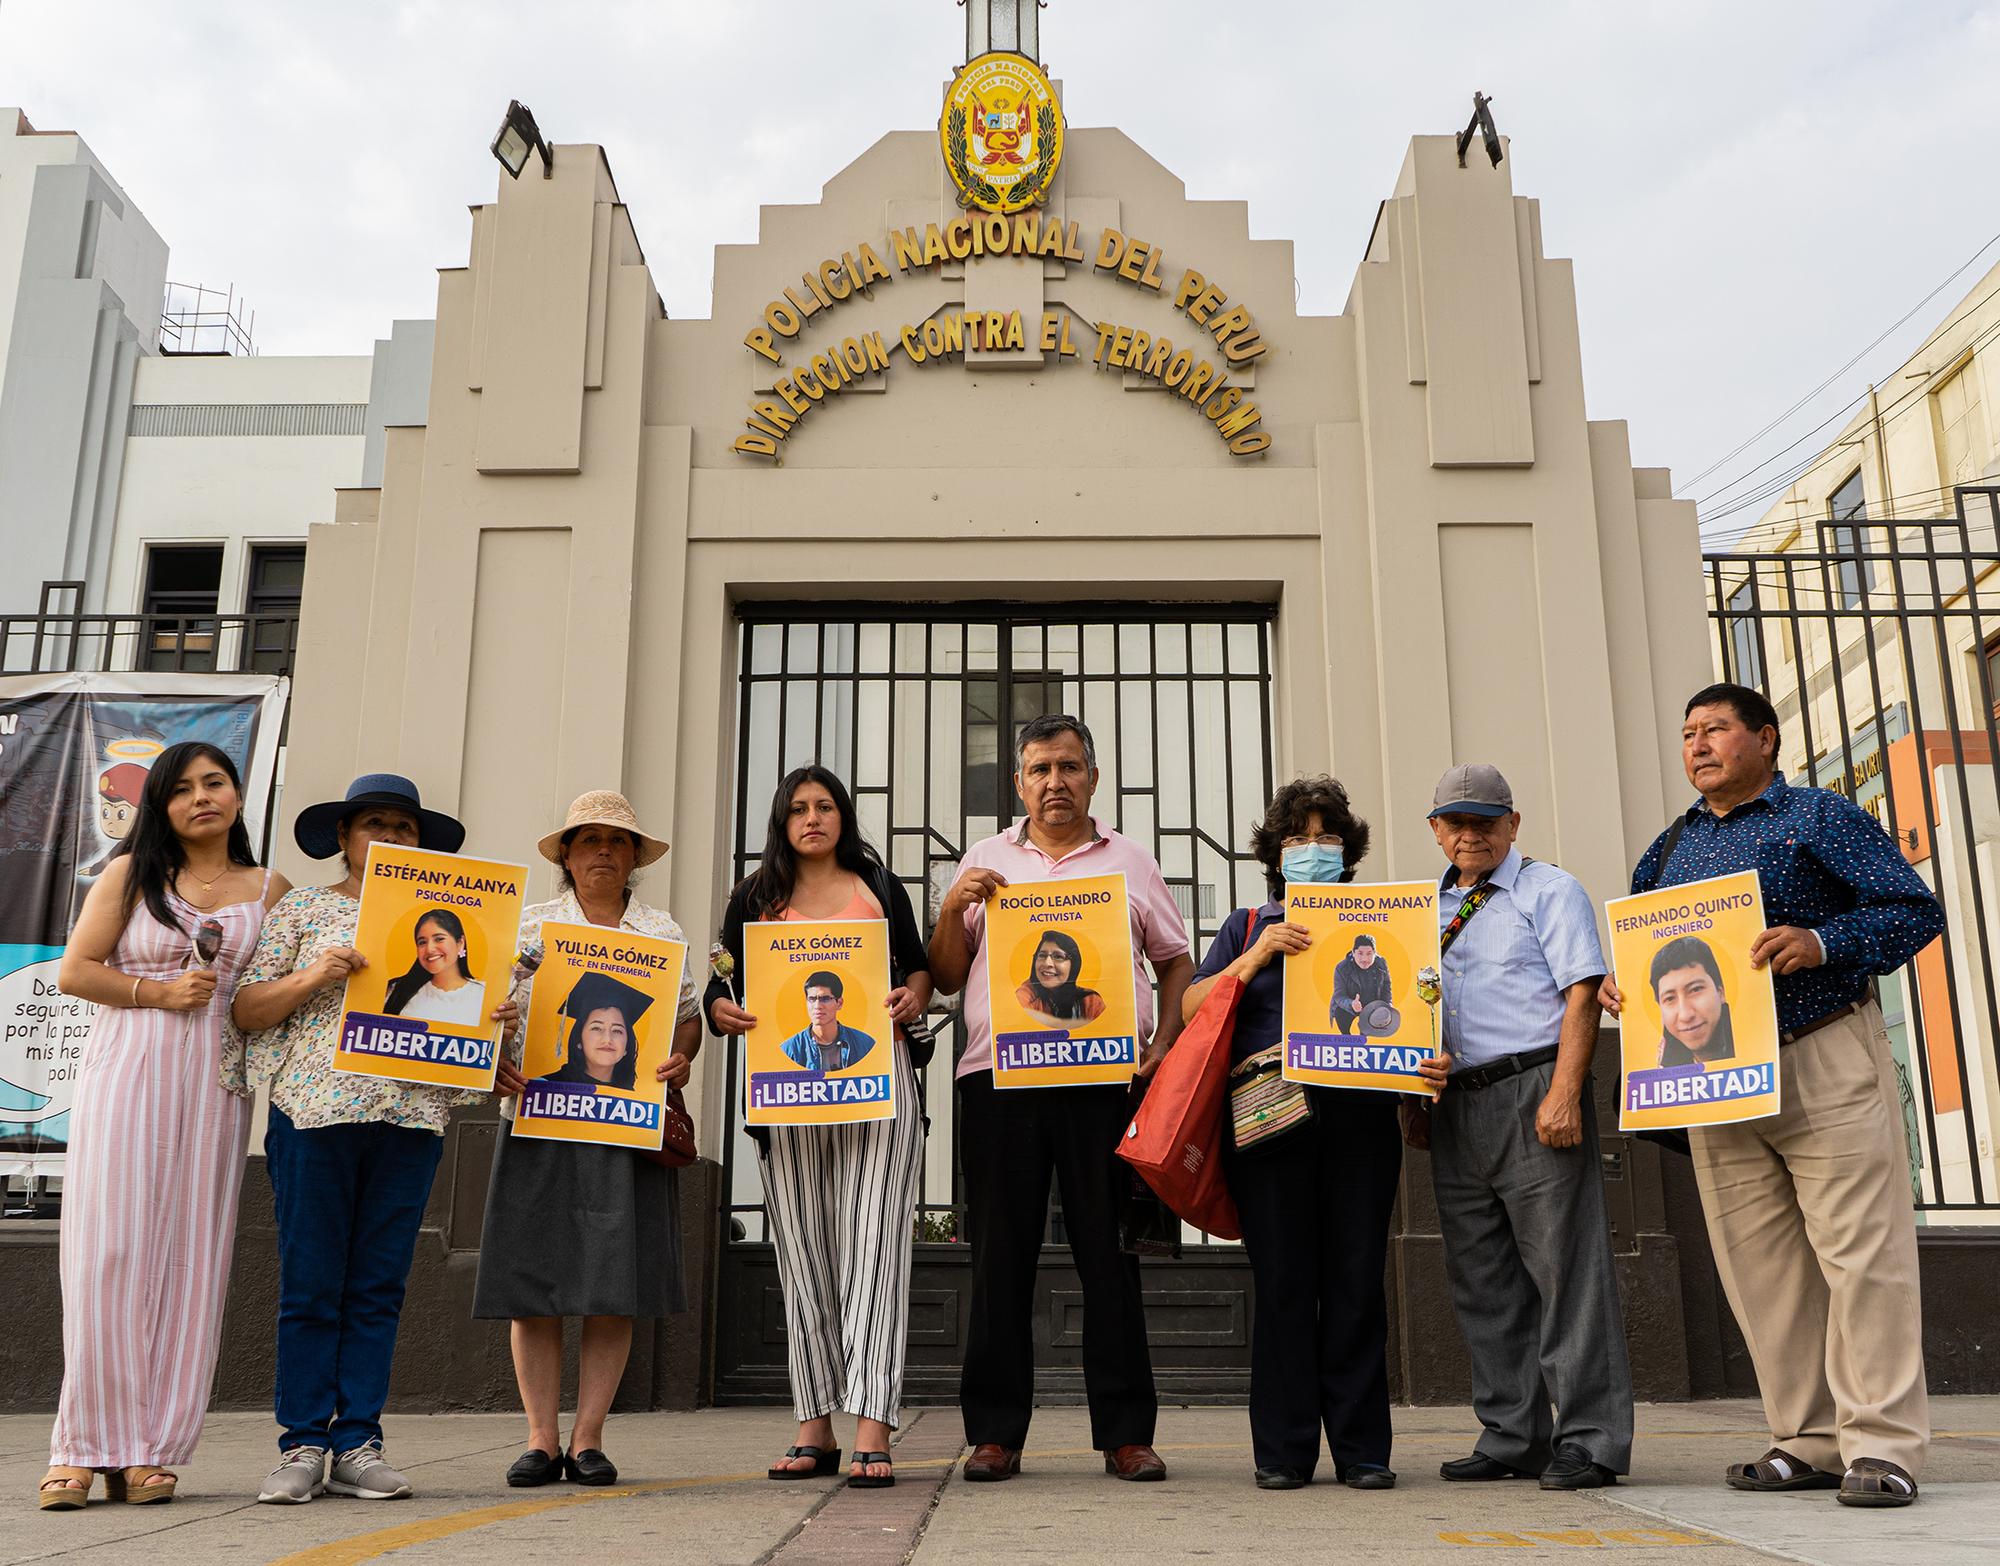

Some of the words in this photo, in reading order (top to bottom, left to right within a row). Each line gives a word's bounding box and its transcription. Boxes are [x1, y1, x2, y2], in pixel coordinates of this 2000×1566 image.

[994, 62, 1044, 97] NACIONAL
[987, 175, 1019, 184] PATRIA
[744, 242, 893, 364] POLICIA
[891, 213, 1084, 270] NACIONAL
[1095, 227, 1164, 291] DEL
[1174, 268, 1267, 362] PERU
[734, 331, 891, 457] DIRECCION
[900, 310, 1025, 363] CONTRA
[1040, 312, 1077, 356] EL
[1094, 321, 1273, 456] TERRORISMO
[374, 863, 451, 886] ESTÉFANY
[453, 875, 518, 897] ALANYA
[416, 889, 483, 908] PSICÓLOGA
[999, 892, 1045, 910] ROCÍO
[1048, 891, 1112, 907] LEANDRO
[1290, 896, 1375, 909] ALEJANDRO
[1378, 895, 1433, 910] MANAY
[1029, 912, 1083, 923] ACTIVISTA
[1338, 913, 1389, 923] DOCENTE
[1615, 905, 1691, 933] FERNANDO
[1694, 893, 1754, 918] QUINTO
[1652, 918, 1713, 940] INGENIERO
[770, 938, 807, 951] ALEX
[809, 934, 863, 949] GÓMEZ
[555, 939, 609, 960] YULISA
[613, 947, 669, 971] GÓMEZ
[789, 952, 850, 963] ESTUDIANTE
[567, 957, 585, 968] TÉC.
[587, 960, 599, 970] EN
[600, 963, 652, 979] ENFERMERÍA
[15, 999, 79, 1023] seguiré
[5, 1025, 38, 1042] por
[46, 1021, 58, 1039] la
[26, 1044, 54, 1060] mis
[344, 1025, 489, 1066] ¡LIBERTAD!
[1000, 1038, 1129, 1073] ¡LIBERTAD!
[755, 1076, 884, 1110] ¡LIBERTAD!
[1631, 1064, 1769, 1113] ¡LIBERTAD!
[523, 1092, 653, 1126] ¡LIBERTAD!
